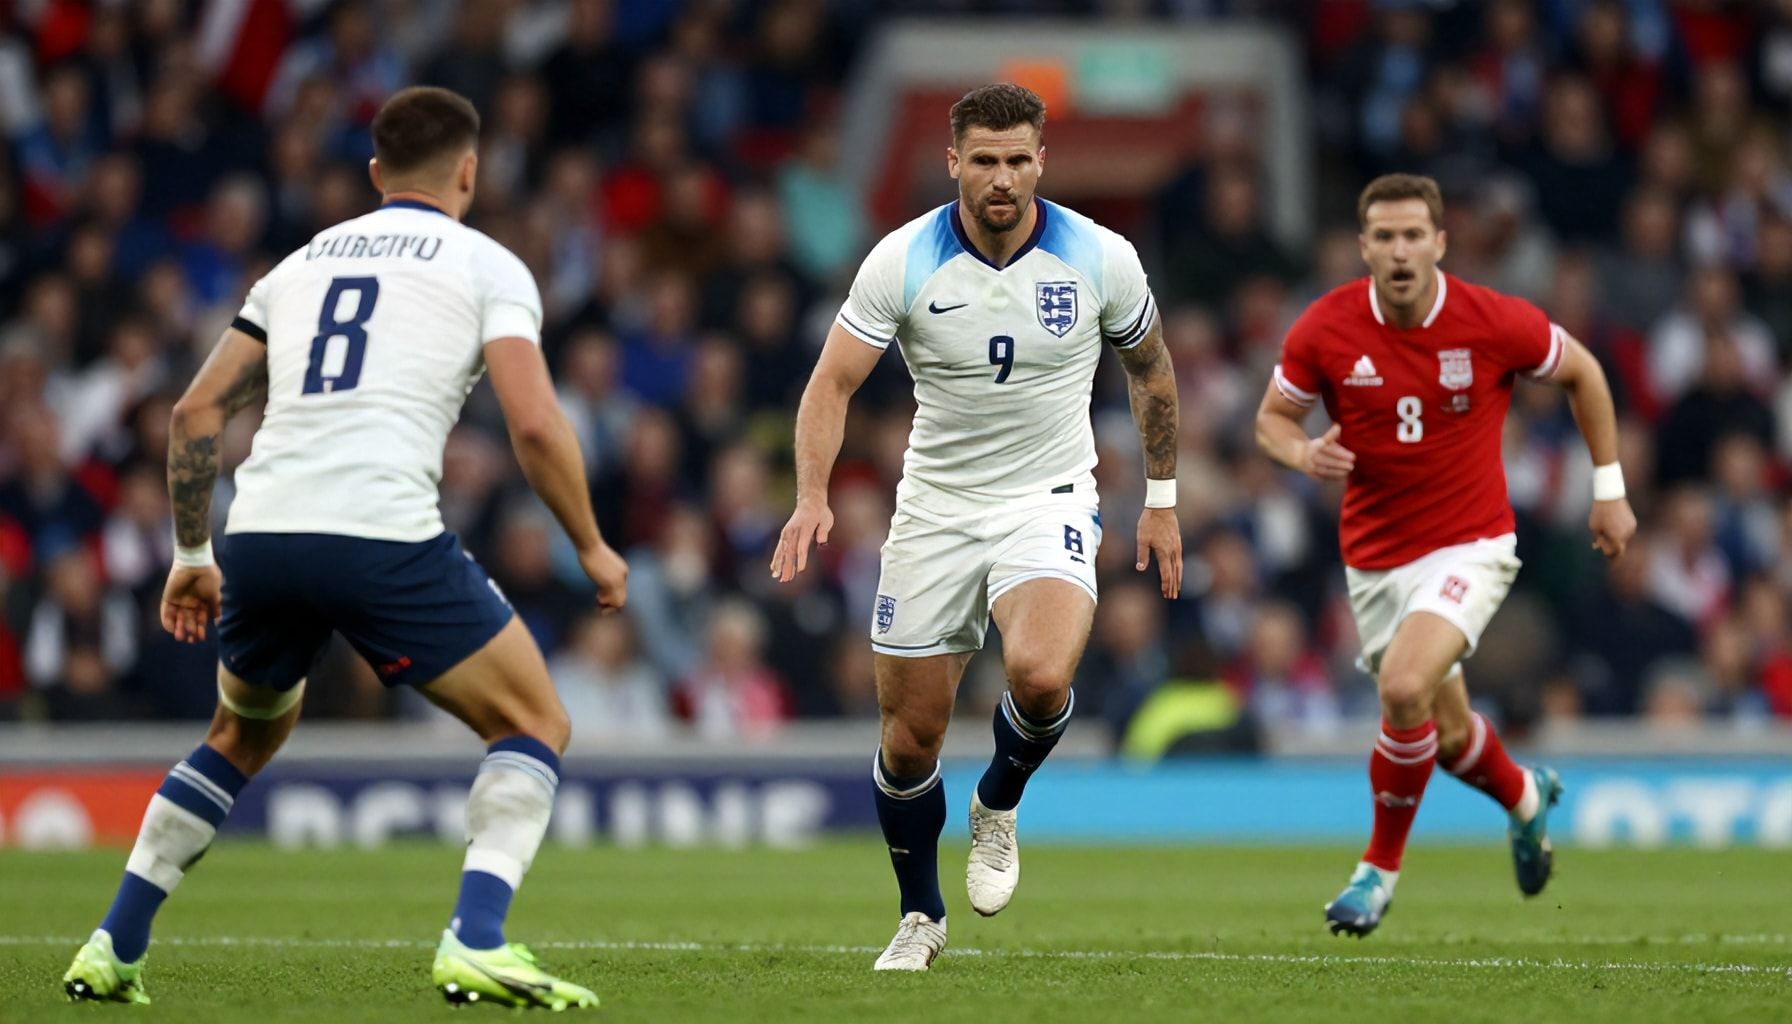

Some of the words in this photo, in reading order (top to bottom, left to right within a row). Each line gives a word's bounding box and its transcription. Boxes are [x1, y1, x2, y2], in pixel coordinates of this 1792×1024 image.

[302, 276, 380, 394] 8
[989, 335, 1015, 384] 9
[1397, 396, 1423, 443] 8
